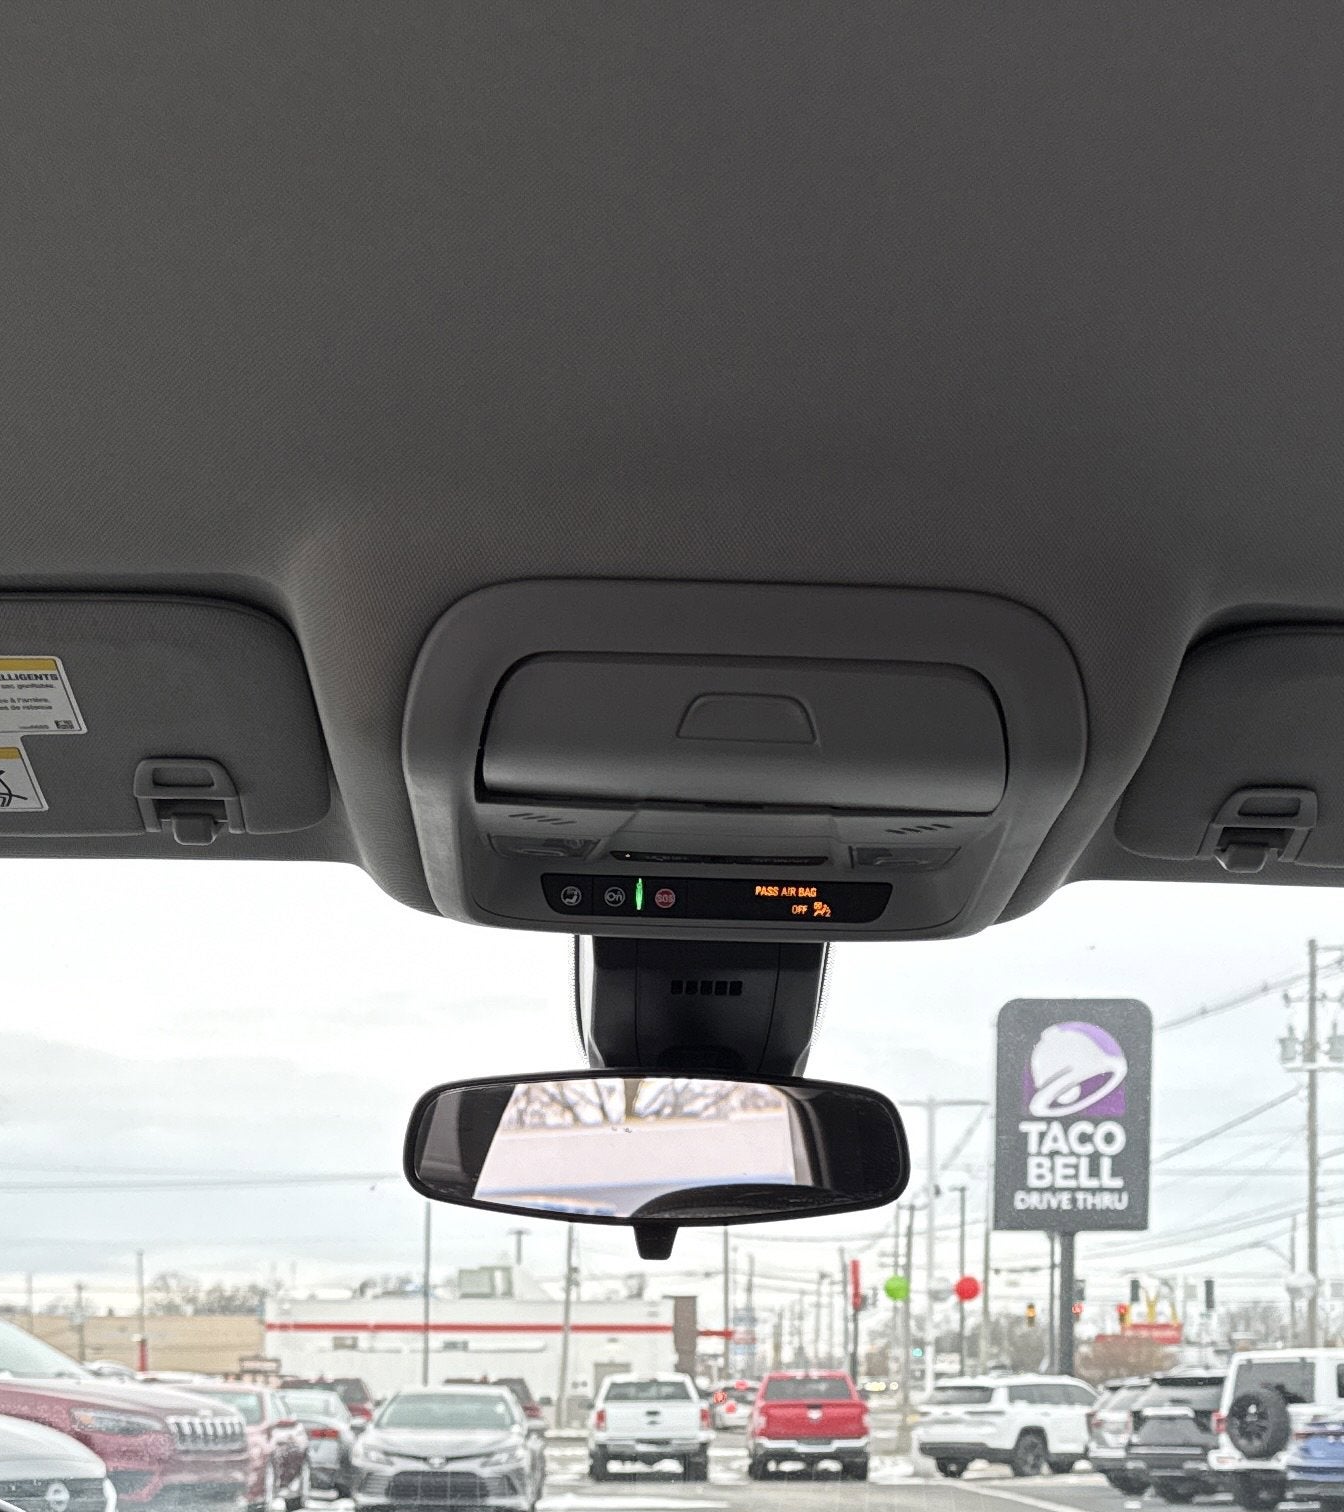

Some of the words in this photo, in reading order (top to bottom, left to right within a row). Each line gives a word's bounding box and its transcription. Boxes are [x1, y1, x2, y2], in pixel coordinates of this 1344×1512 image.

[754, 885, 779, 896] PASS
[781, 887, 796, 897] AIR
[798, 887, 817, 897] BAG
[791, 904, 808, 914] OFF
[1019, 1121, 1126, 1156] TACO
[1026, 1156, 1124, 1189] BELL
[1013, 1190, 1074, 1211] DRIVE
[1075, 1189, 1128, 1211] THRU
